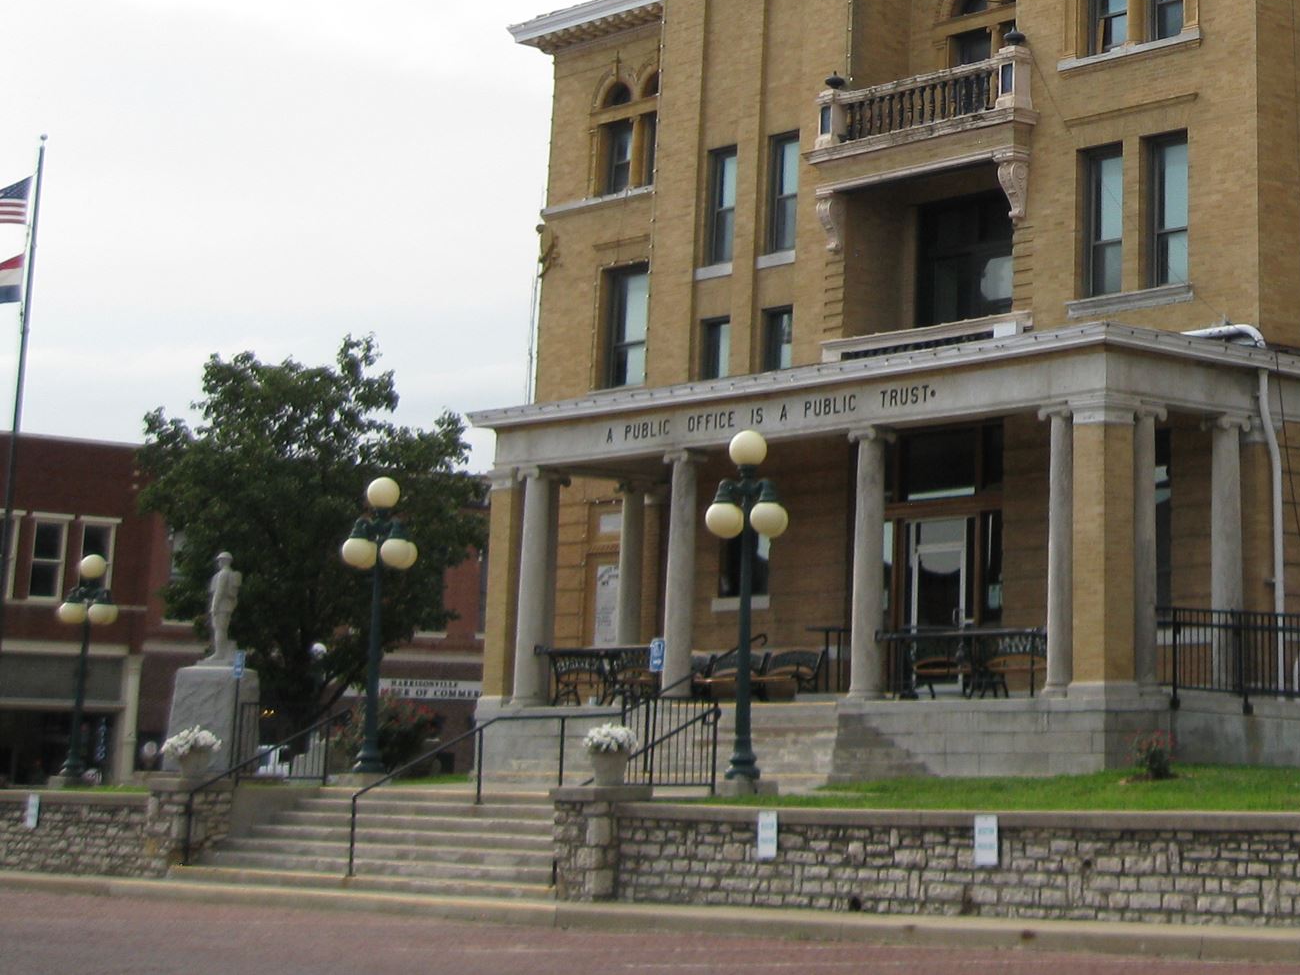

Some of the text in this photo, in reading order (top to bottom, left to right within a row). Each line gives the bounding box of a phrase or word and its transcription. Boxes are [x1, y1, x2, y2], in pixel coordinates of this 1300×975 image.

[606, 428, 613, 443] A
[624, 419, 671, 441] PUBLIC
[688, 411, 736, 432] OFFICE
[751, 407, 763, 425] IS
[779, 404, 788, 421] A
[804, 394, 857, 418] PUBLIC
[416, 689, 428, 698] OF
